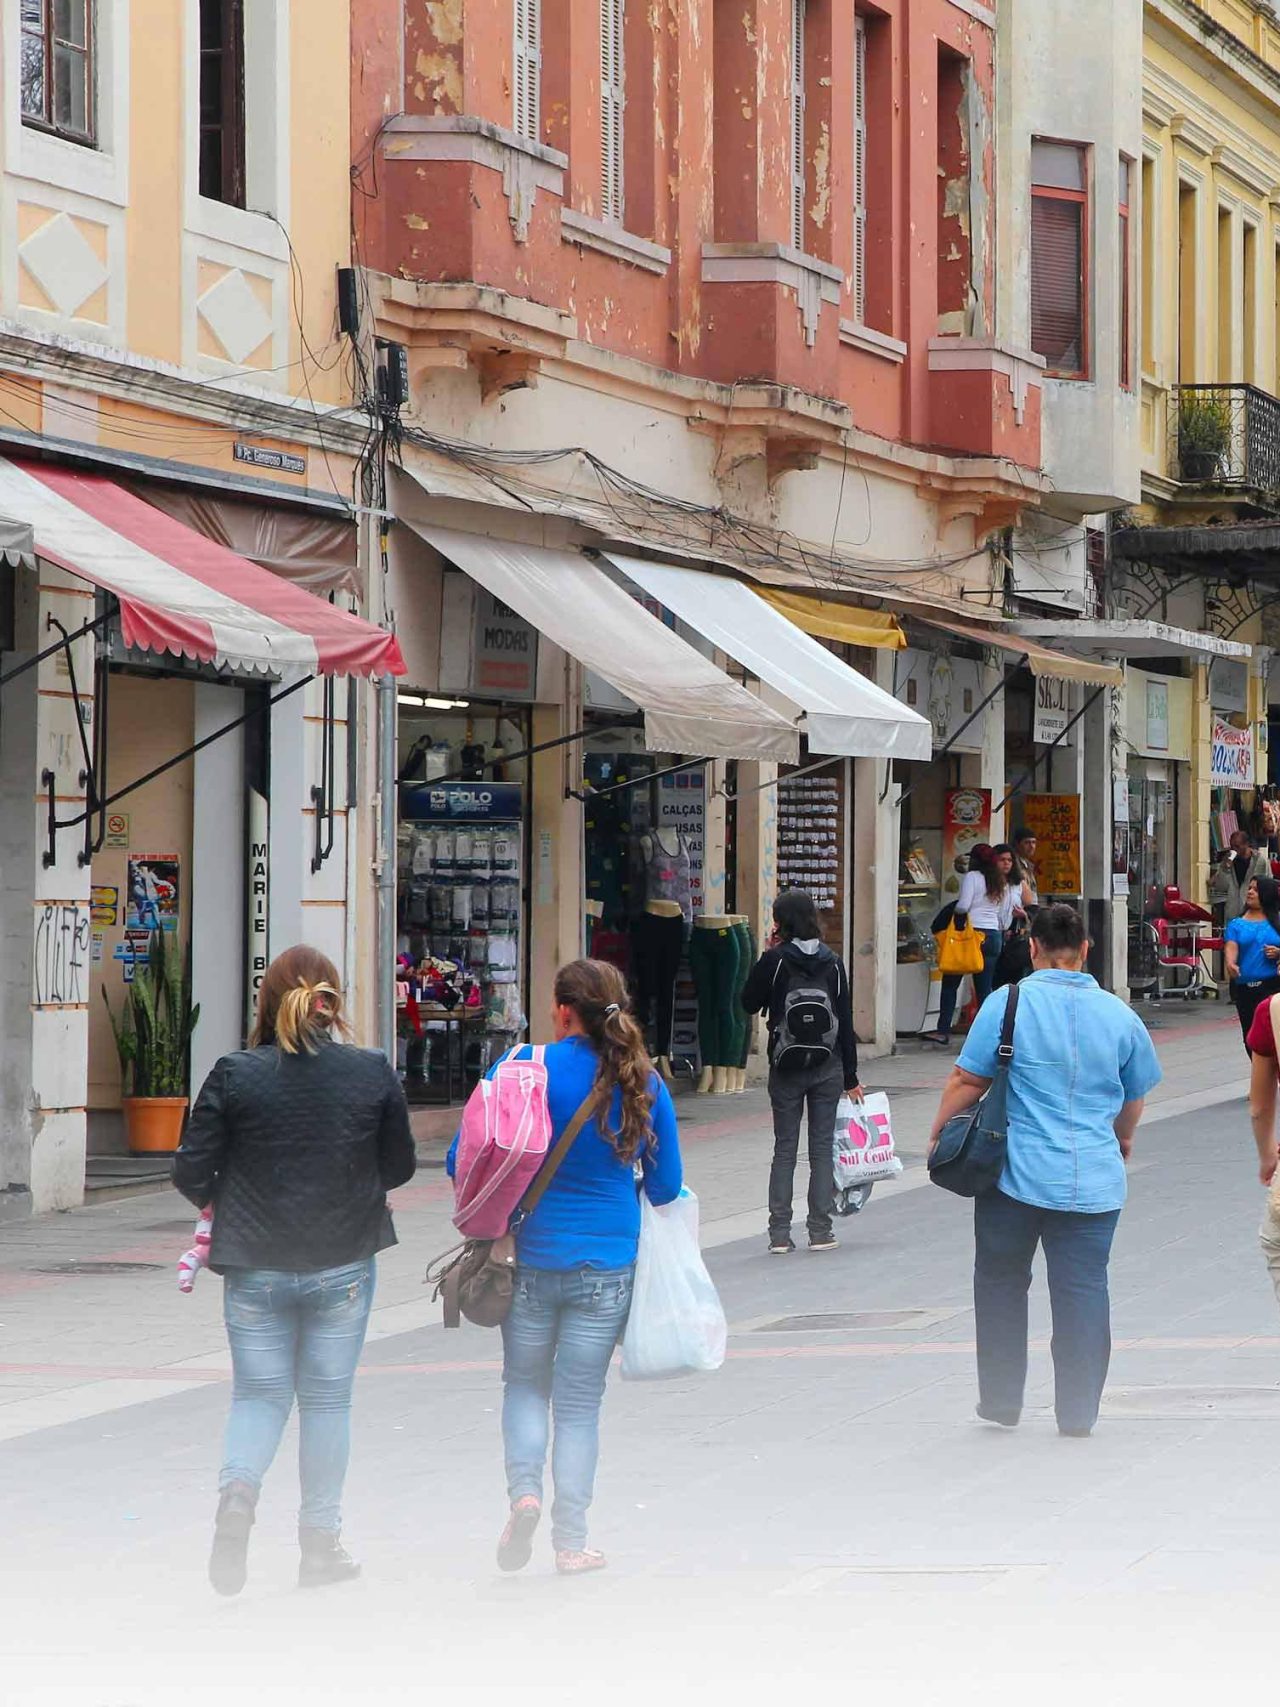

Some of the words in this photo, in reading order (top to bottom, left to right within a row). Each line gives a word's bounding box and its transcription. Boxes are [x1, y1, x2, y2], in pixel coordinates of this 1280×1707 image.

[254, 449, 280, 466] Generoso
[282, 455, 304, 471] Marques
[484, 626, 528, 651] MODAS
[449, 792, 492, 803] POLO
[662, 804, 702, 817] CALÇAS
[675, 823, 702, 833] USAS
[252, 843, 266, 933] MARIE
